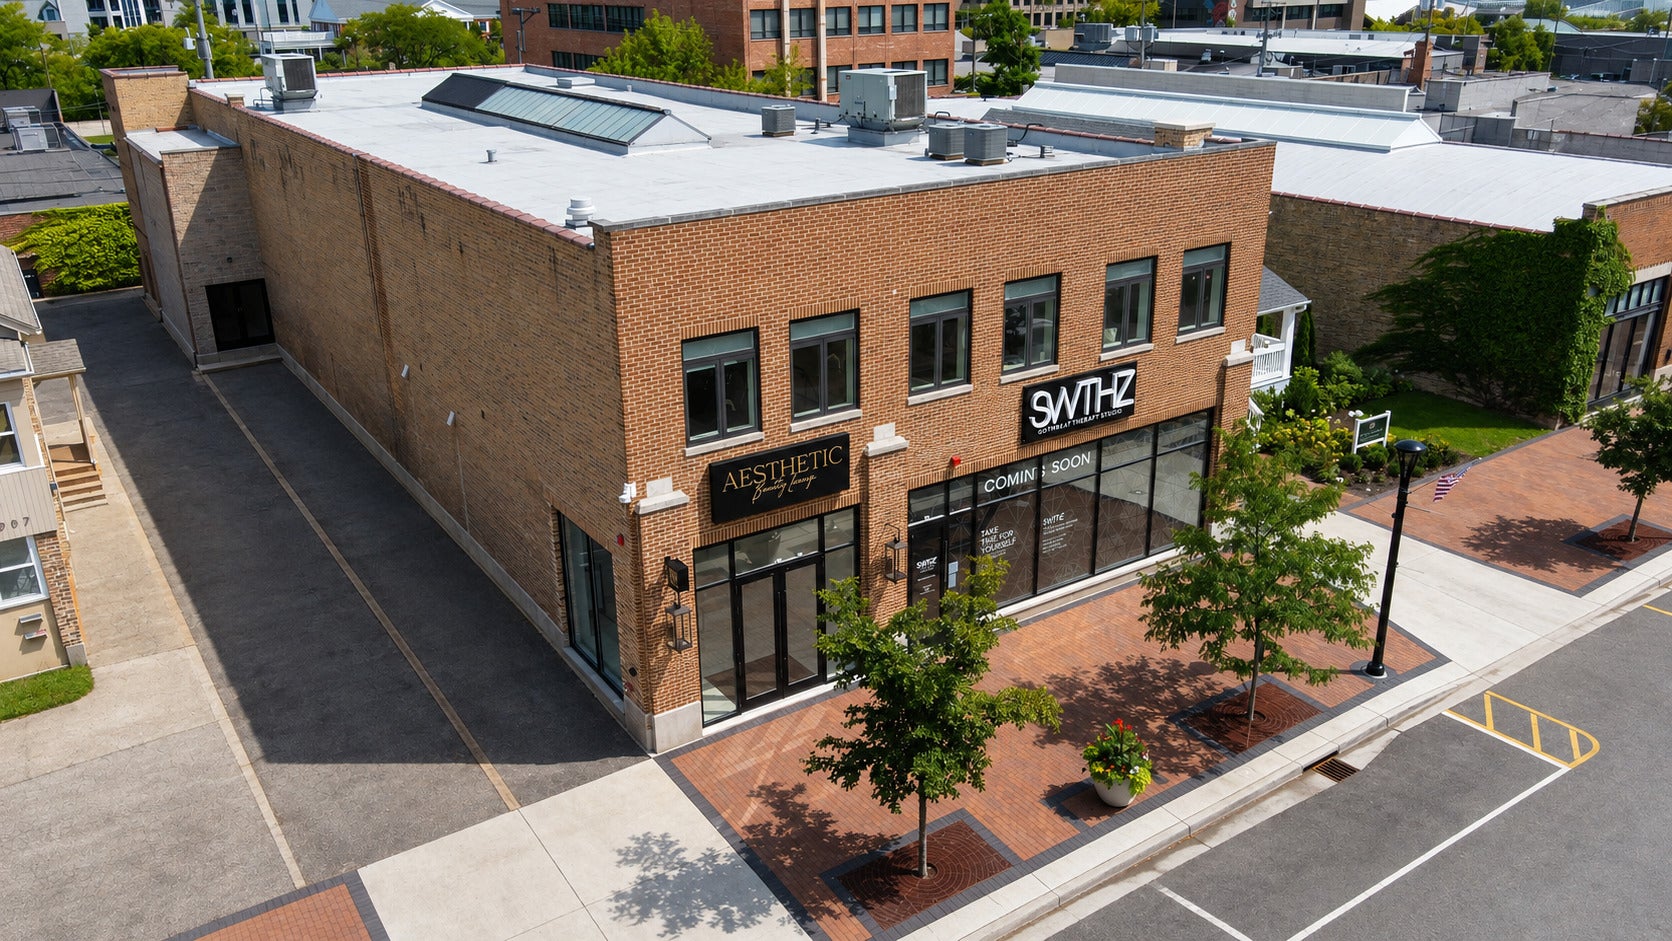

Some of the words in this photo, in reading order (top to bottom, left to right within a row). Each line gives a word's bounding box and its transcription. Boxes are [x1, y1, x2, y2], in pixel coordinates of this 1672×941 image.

[1029, 369, 1136, 429] SWTHZ
[721, 445, 843, 493] AESTHETIC
[1051, 451, 1091, 474] SOON
